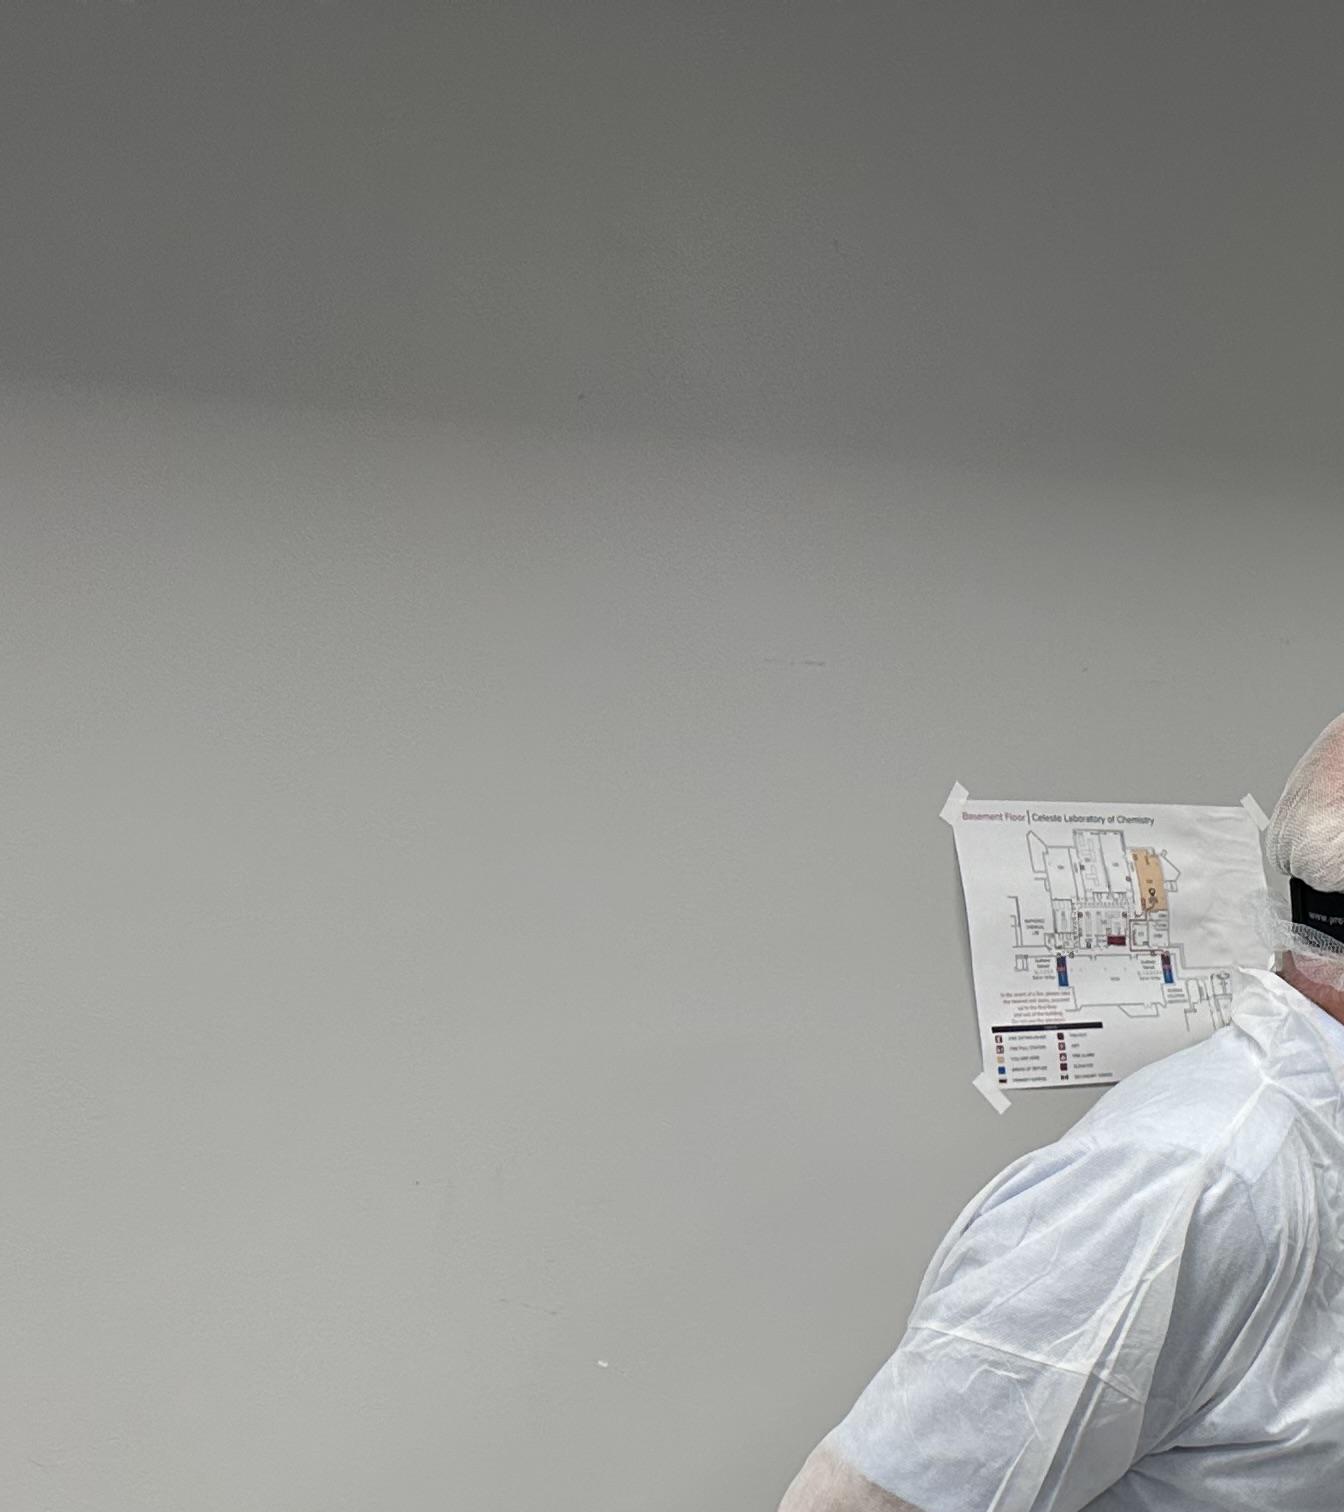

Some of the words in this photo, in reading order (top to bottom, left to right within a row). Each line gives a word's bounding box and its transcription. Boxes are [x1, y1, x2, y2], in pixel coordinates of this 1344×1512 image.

[961, 811, 1003, 822] Basement
[1004, 812, 1025, 823] Floor
[1031, 813, 1063, 823] Celeste
[1064, 814, 1105, 825] Laboratory
[1107, 815, 1116, 824] of
[1117, 815, 1155, 827] Chemistry
